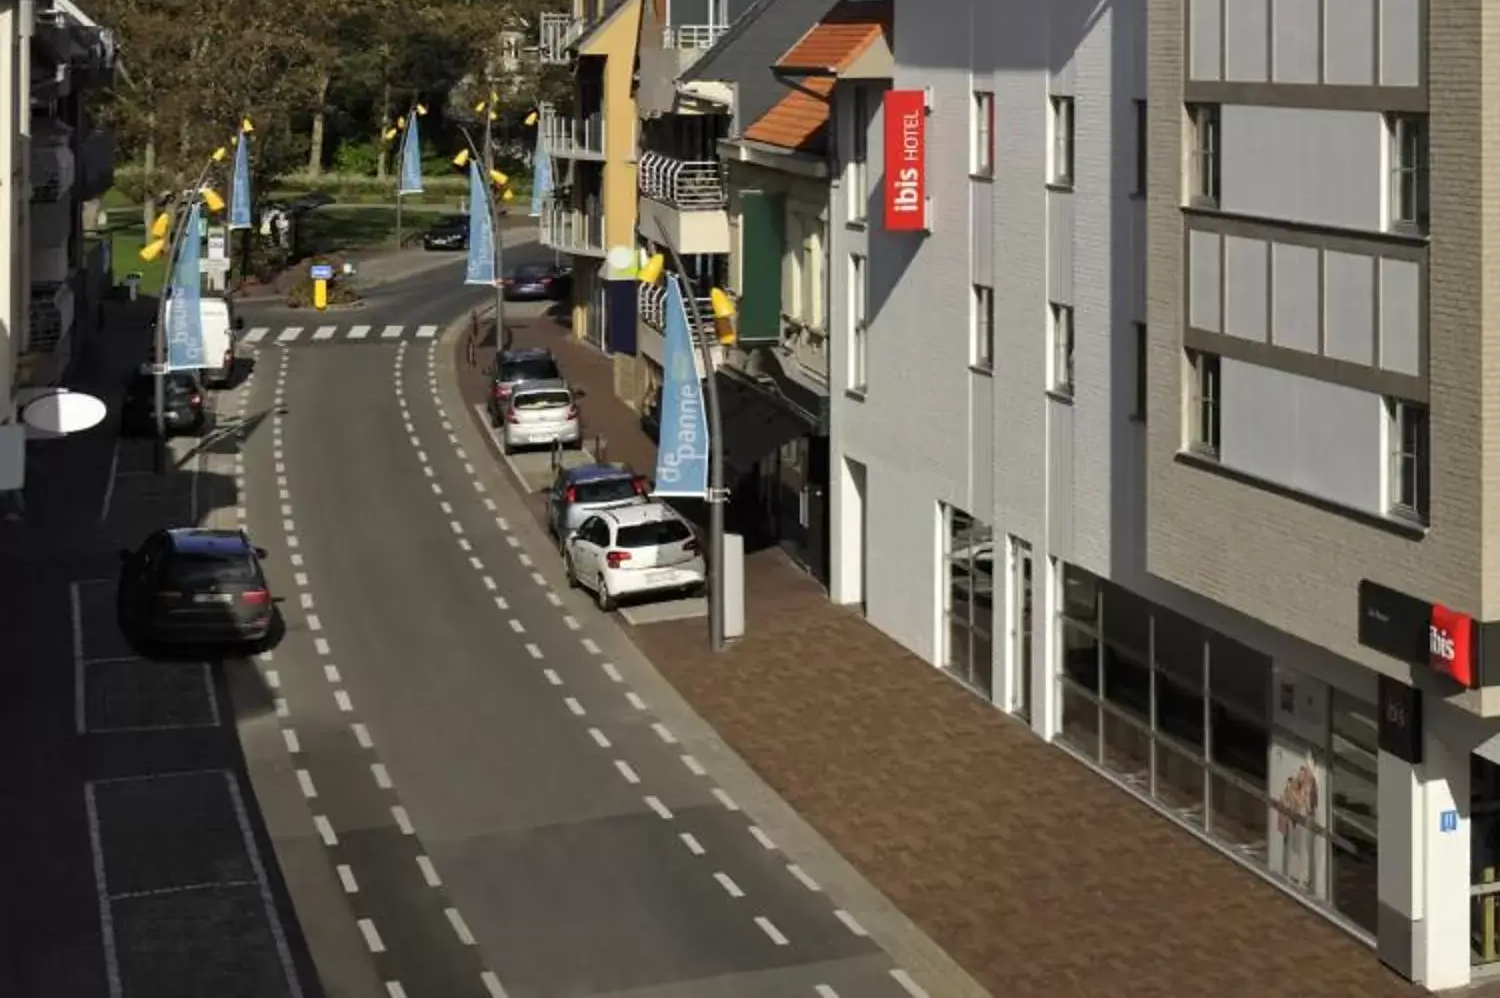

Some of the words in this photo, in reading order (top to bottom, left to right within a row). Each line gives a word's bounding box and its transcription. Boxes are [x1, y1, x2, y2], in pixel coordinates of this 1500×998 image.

[903, 109, 919, 161] HOTEL
[893, 168, 919, 212] ibis
[657, 451, 681, 483] de
[676, 384, 706, 463] panne
